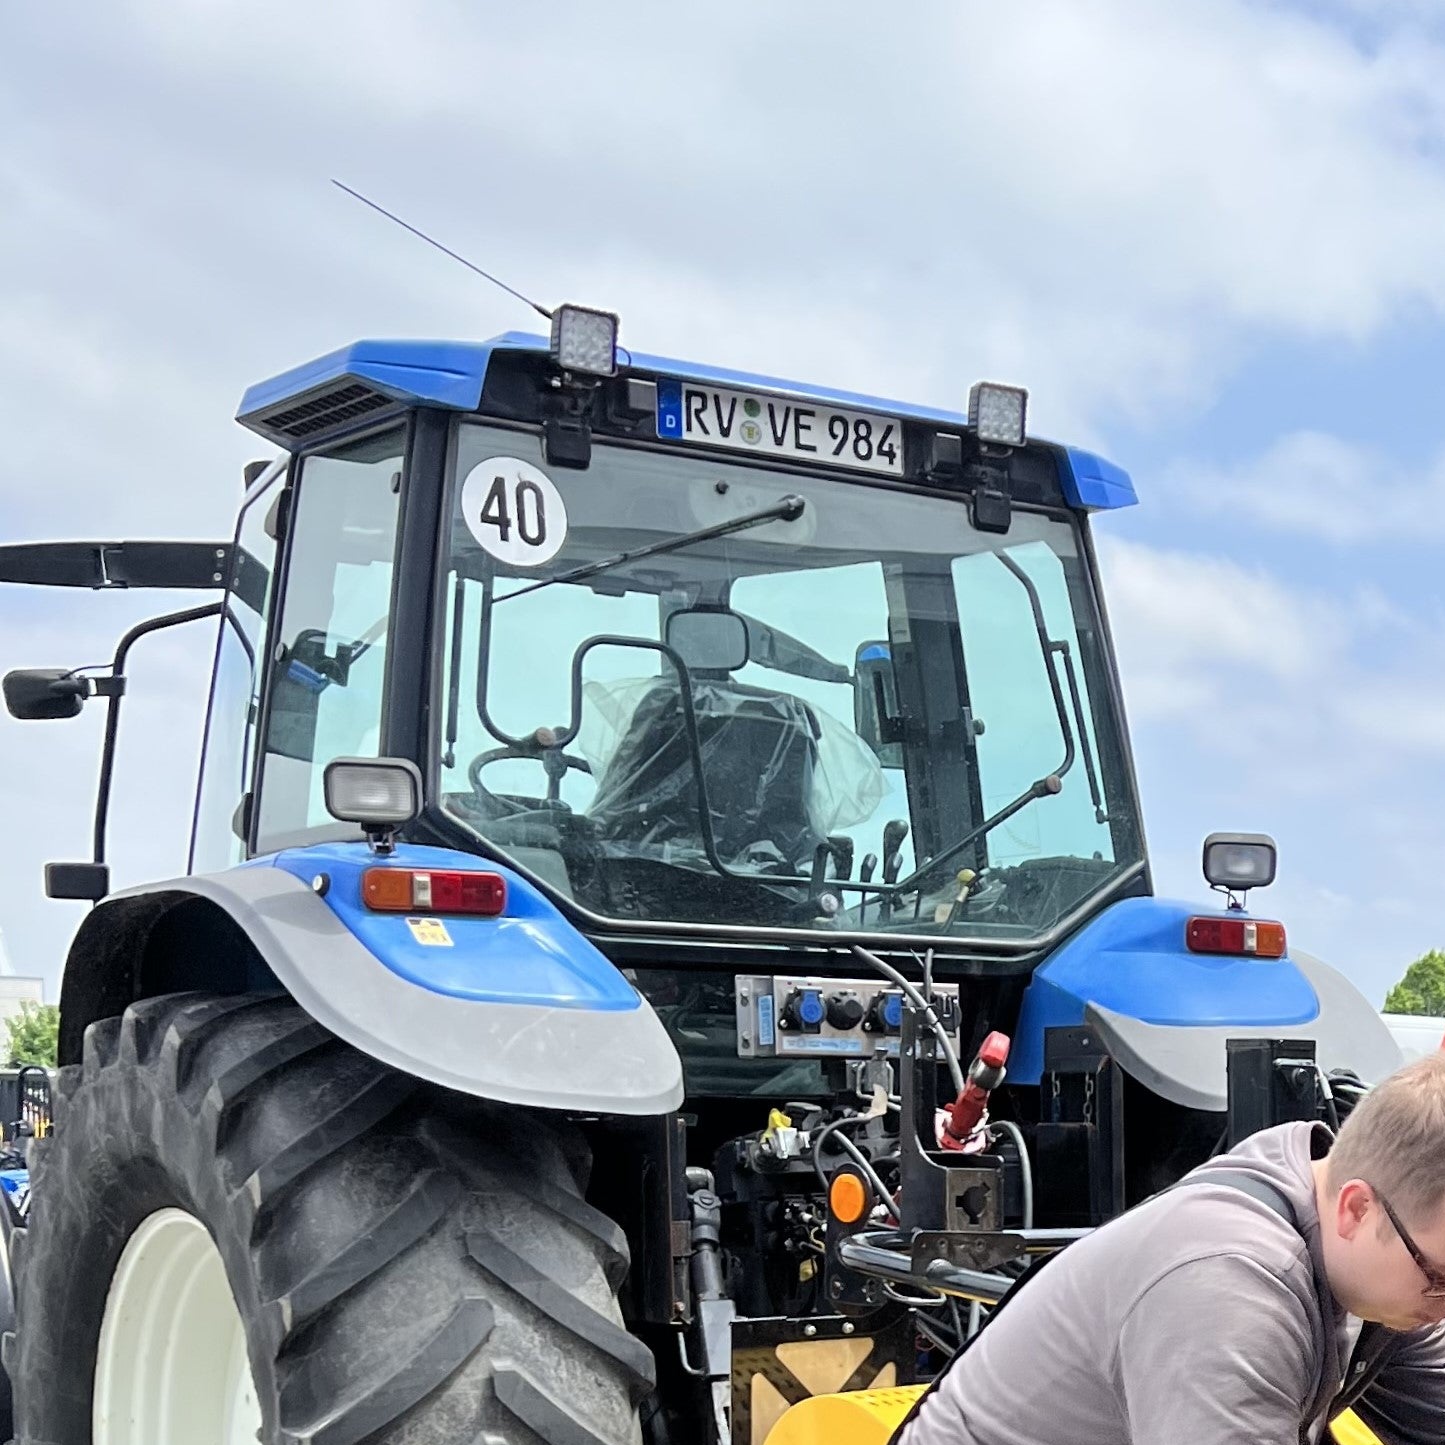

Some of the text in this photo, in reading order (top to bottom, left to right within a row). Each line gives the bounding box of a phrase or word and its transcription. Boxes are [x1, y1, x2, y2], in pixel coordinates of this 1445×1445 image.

[665, 414, 677, 429] D
[685, 389, 897, 466] RV VE 984
[480, 476, 547, 547] 40
